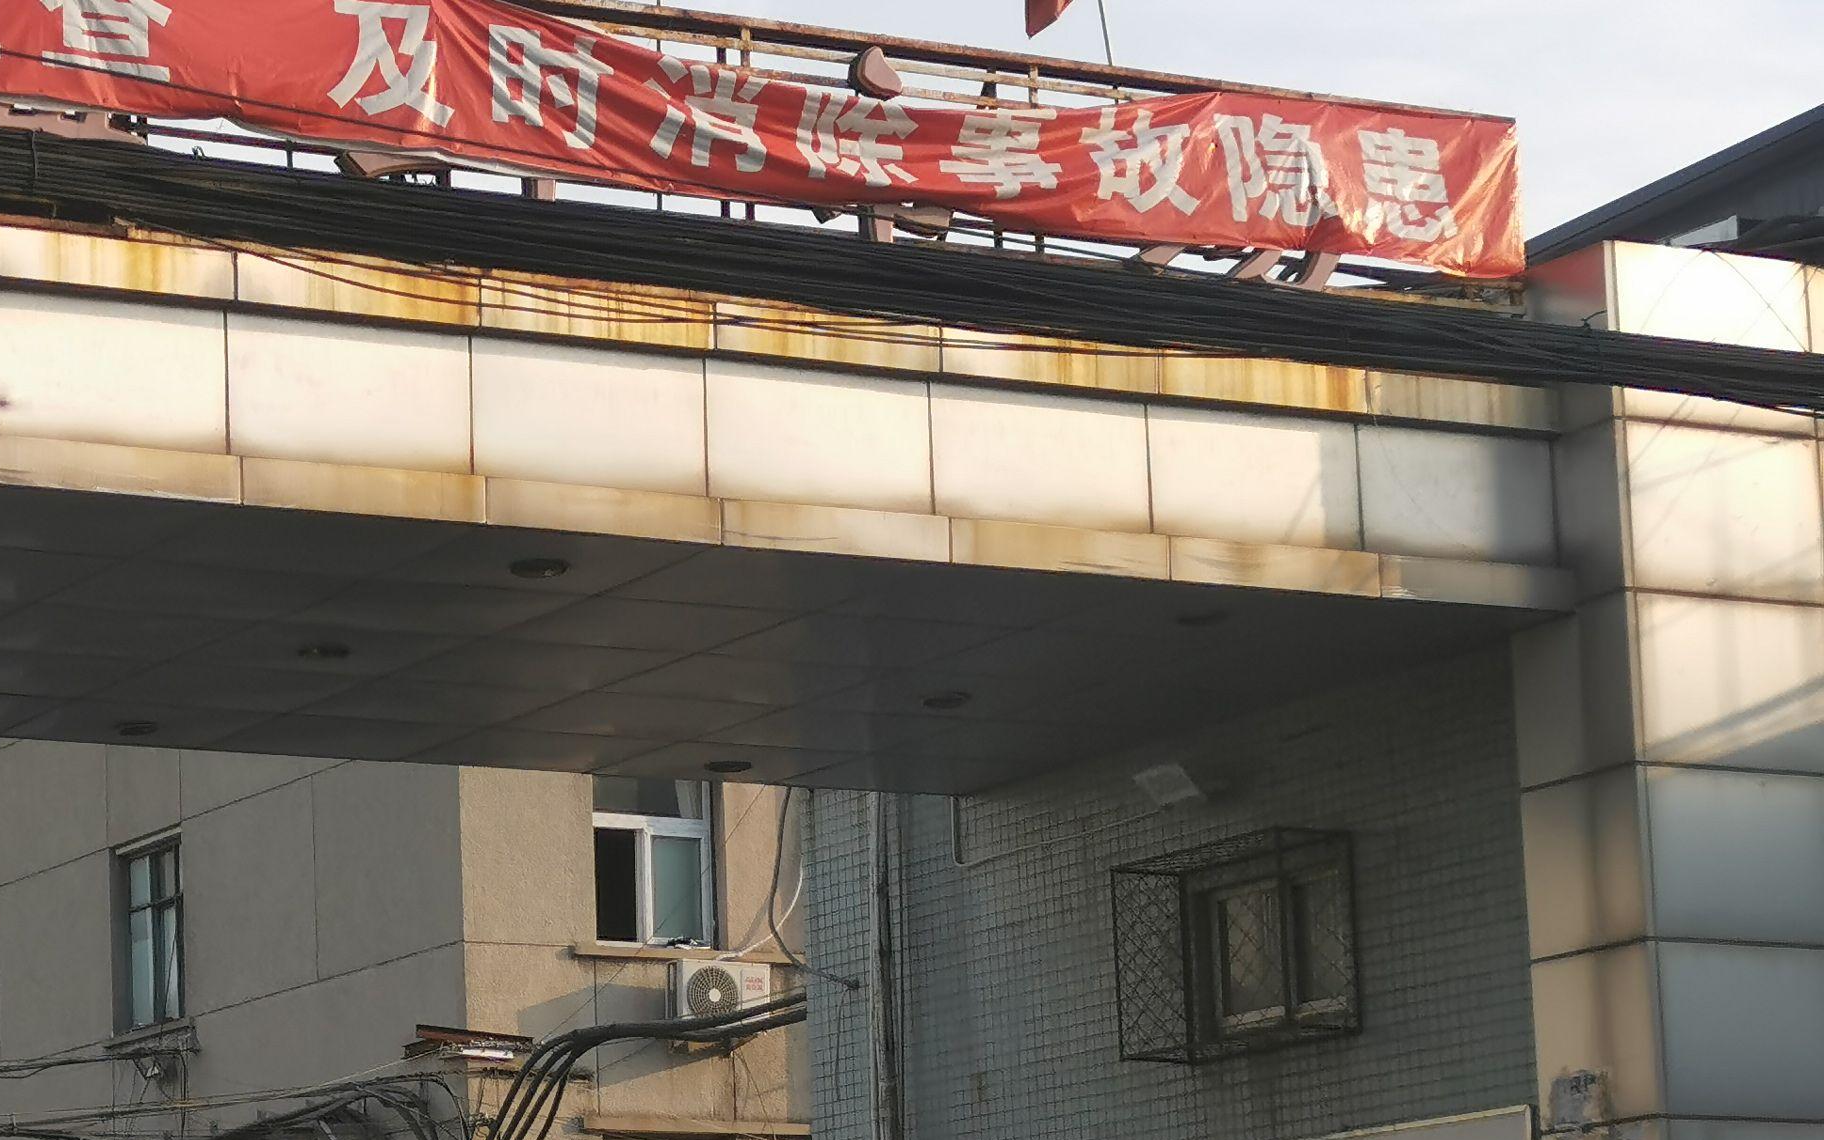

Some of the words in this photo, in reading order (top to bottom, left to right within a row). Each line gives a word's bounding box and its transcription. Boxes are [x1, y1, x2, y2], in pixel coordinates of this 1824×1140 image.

[326, 0, 1458, 244] 及时消除事故隐患
